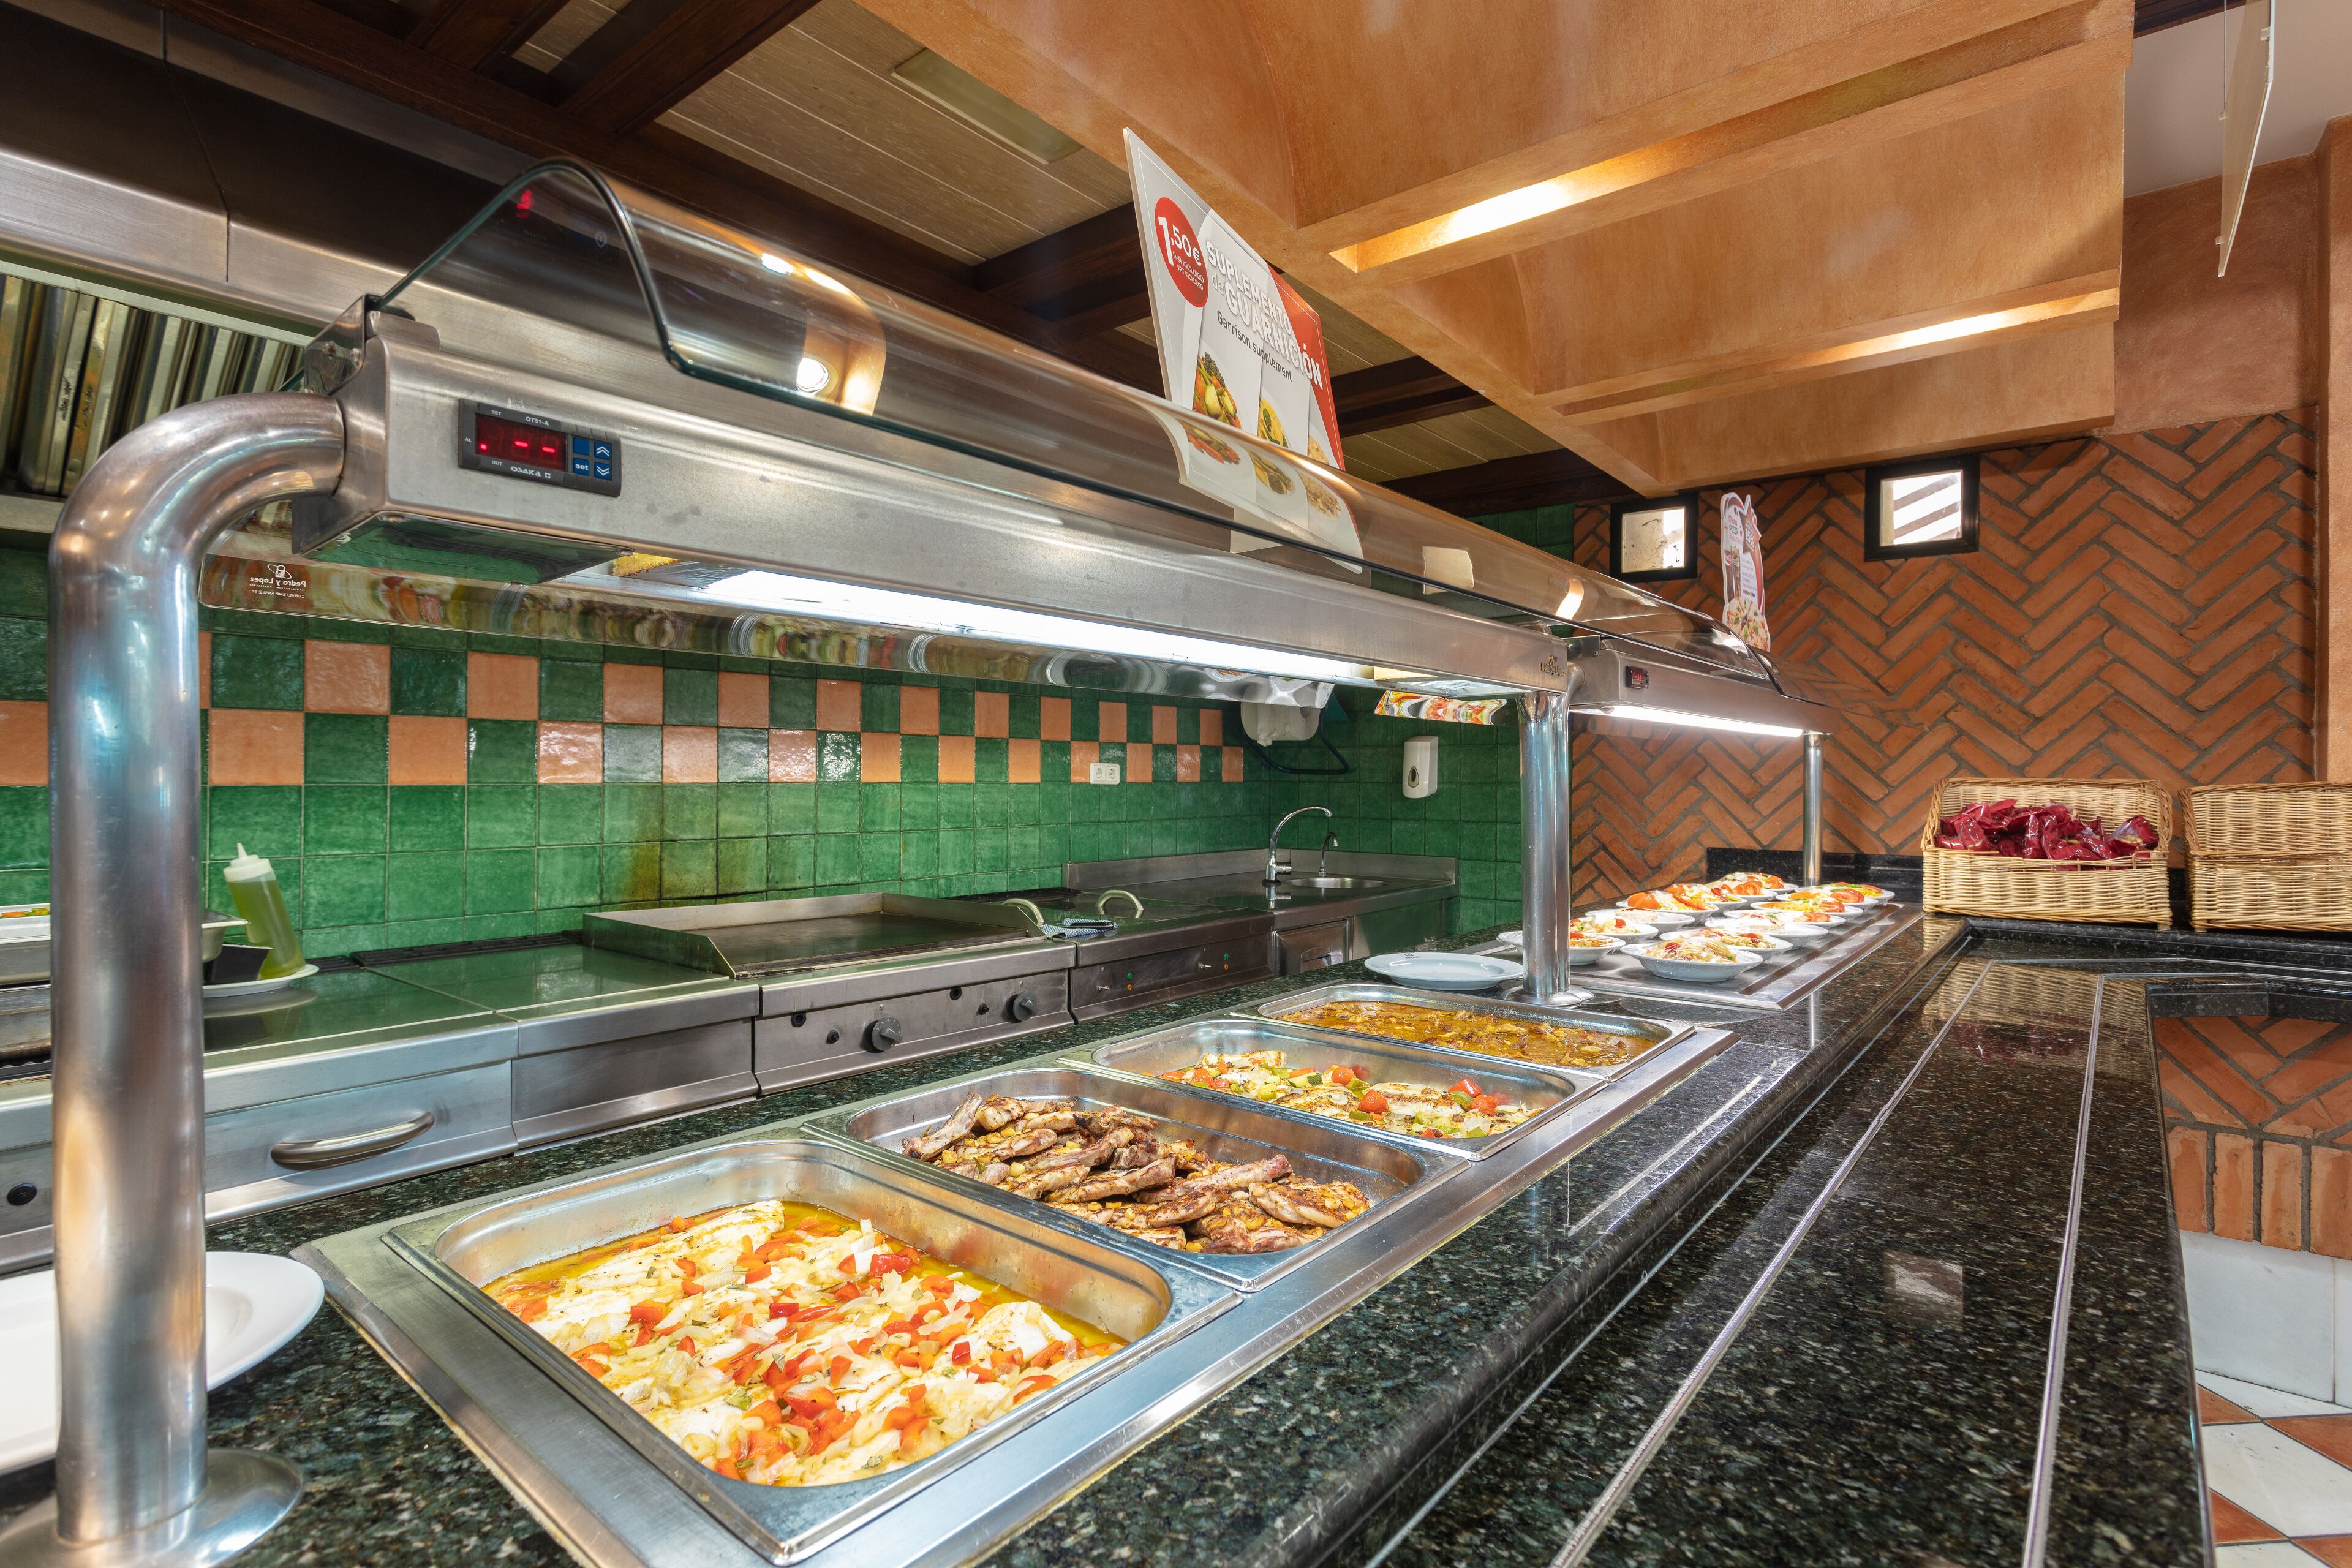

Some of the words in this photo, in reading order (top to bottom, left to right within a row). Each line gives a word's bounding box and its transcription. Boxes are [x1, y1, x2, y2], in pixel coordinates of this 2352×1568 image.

[1158, 216, 1202, 266] 1,50€
[1183, 260, 1204, 283] INCLUIDO
[1185, 271, 1203, 290] INCLUDED
[1207, 241, 1292, 335] SUPLEMENTO
[1212, 272, 1224, 296] de
[1224, 281, 1323, 391] GUARNICIÓN
[1217, 310, 1251, 349] Garrison
[1253, 342, 1292, 383] supplement
[526, 417, 549, 426] OT31-A
[510, 466, 541, 477] OSAKA
